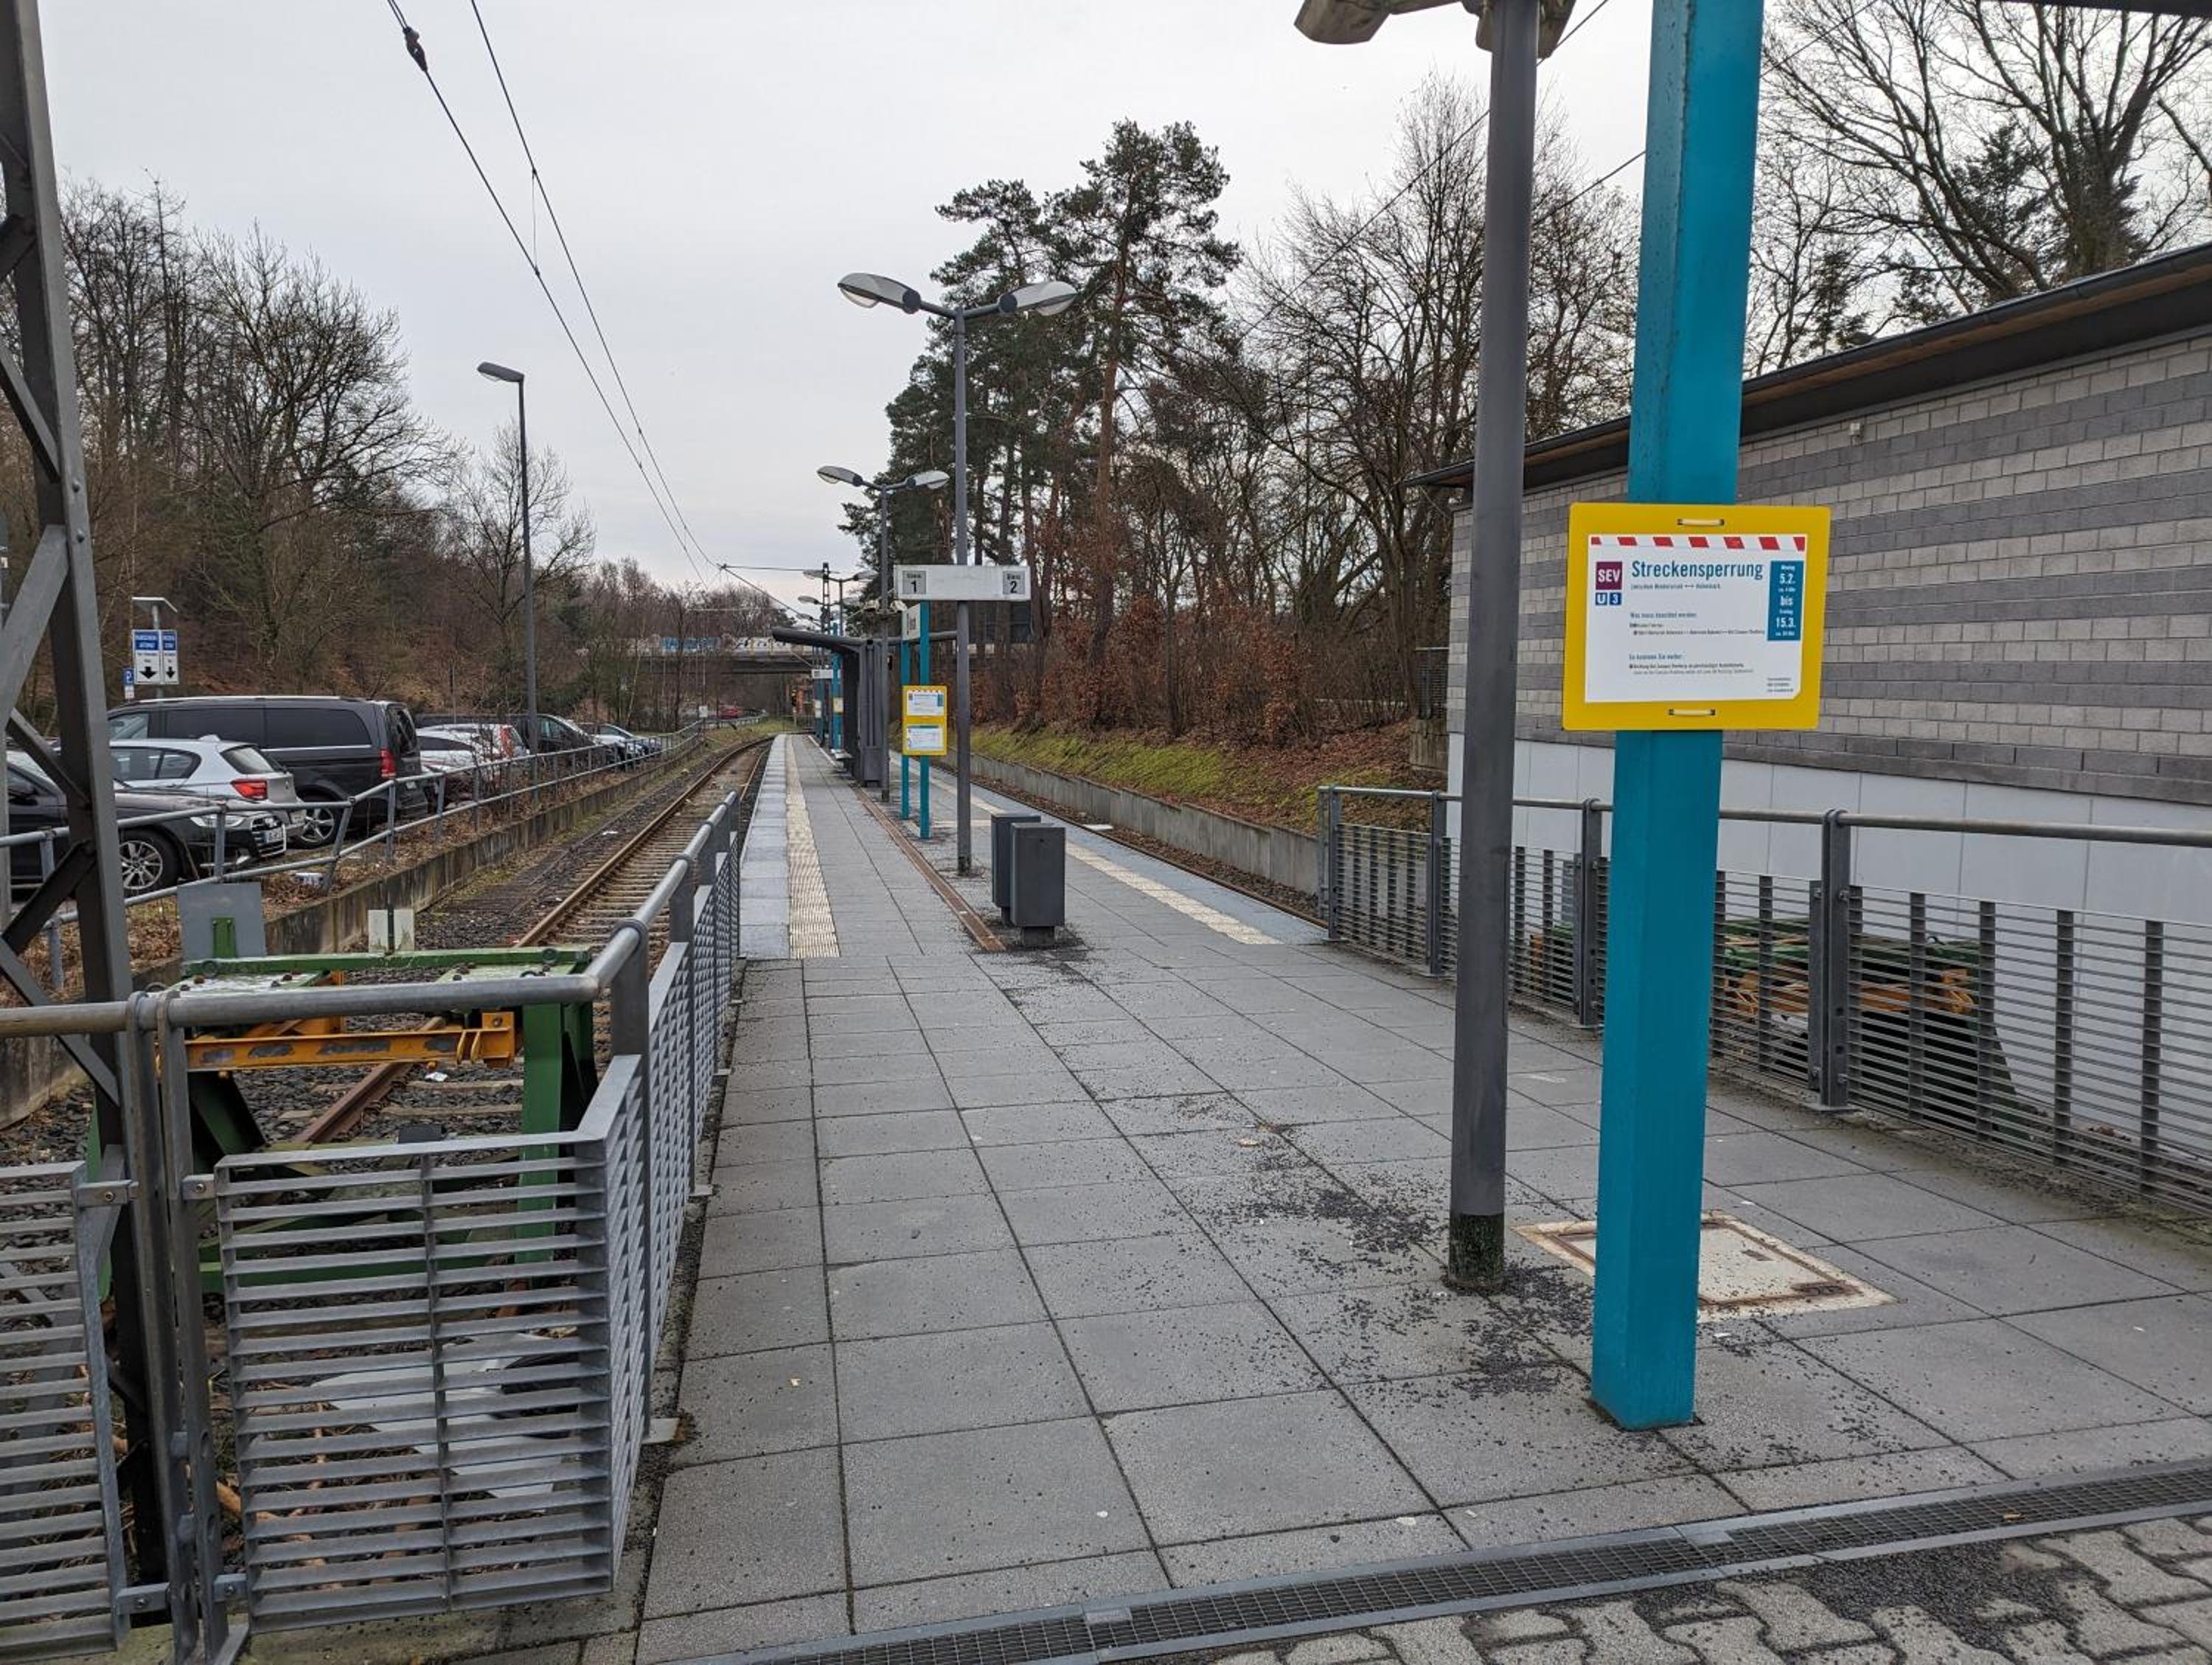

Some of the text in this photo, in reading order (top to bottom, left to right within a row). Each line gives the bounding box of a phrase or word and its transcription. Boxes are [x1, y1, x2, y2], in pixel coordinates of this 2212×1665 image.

[1598, 569, 1621, 583] SEV
[1632, 560, 1764, 580] Streckensperrung
[911, 580, 917, 593] 1
[1009, 580, 1018, 594] 2
[1597, 594, 1619, 605] U 3
[1780, 595, 1793, 606] bis
[1775, 616, 1797, 628] 15.3.
